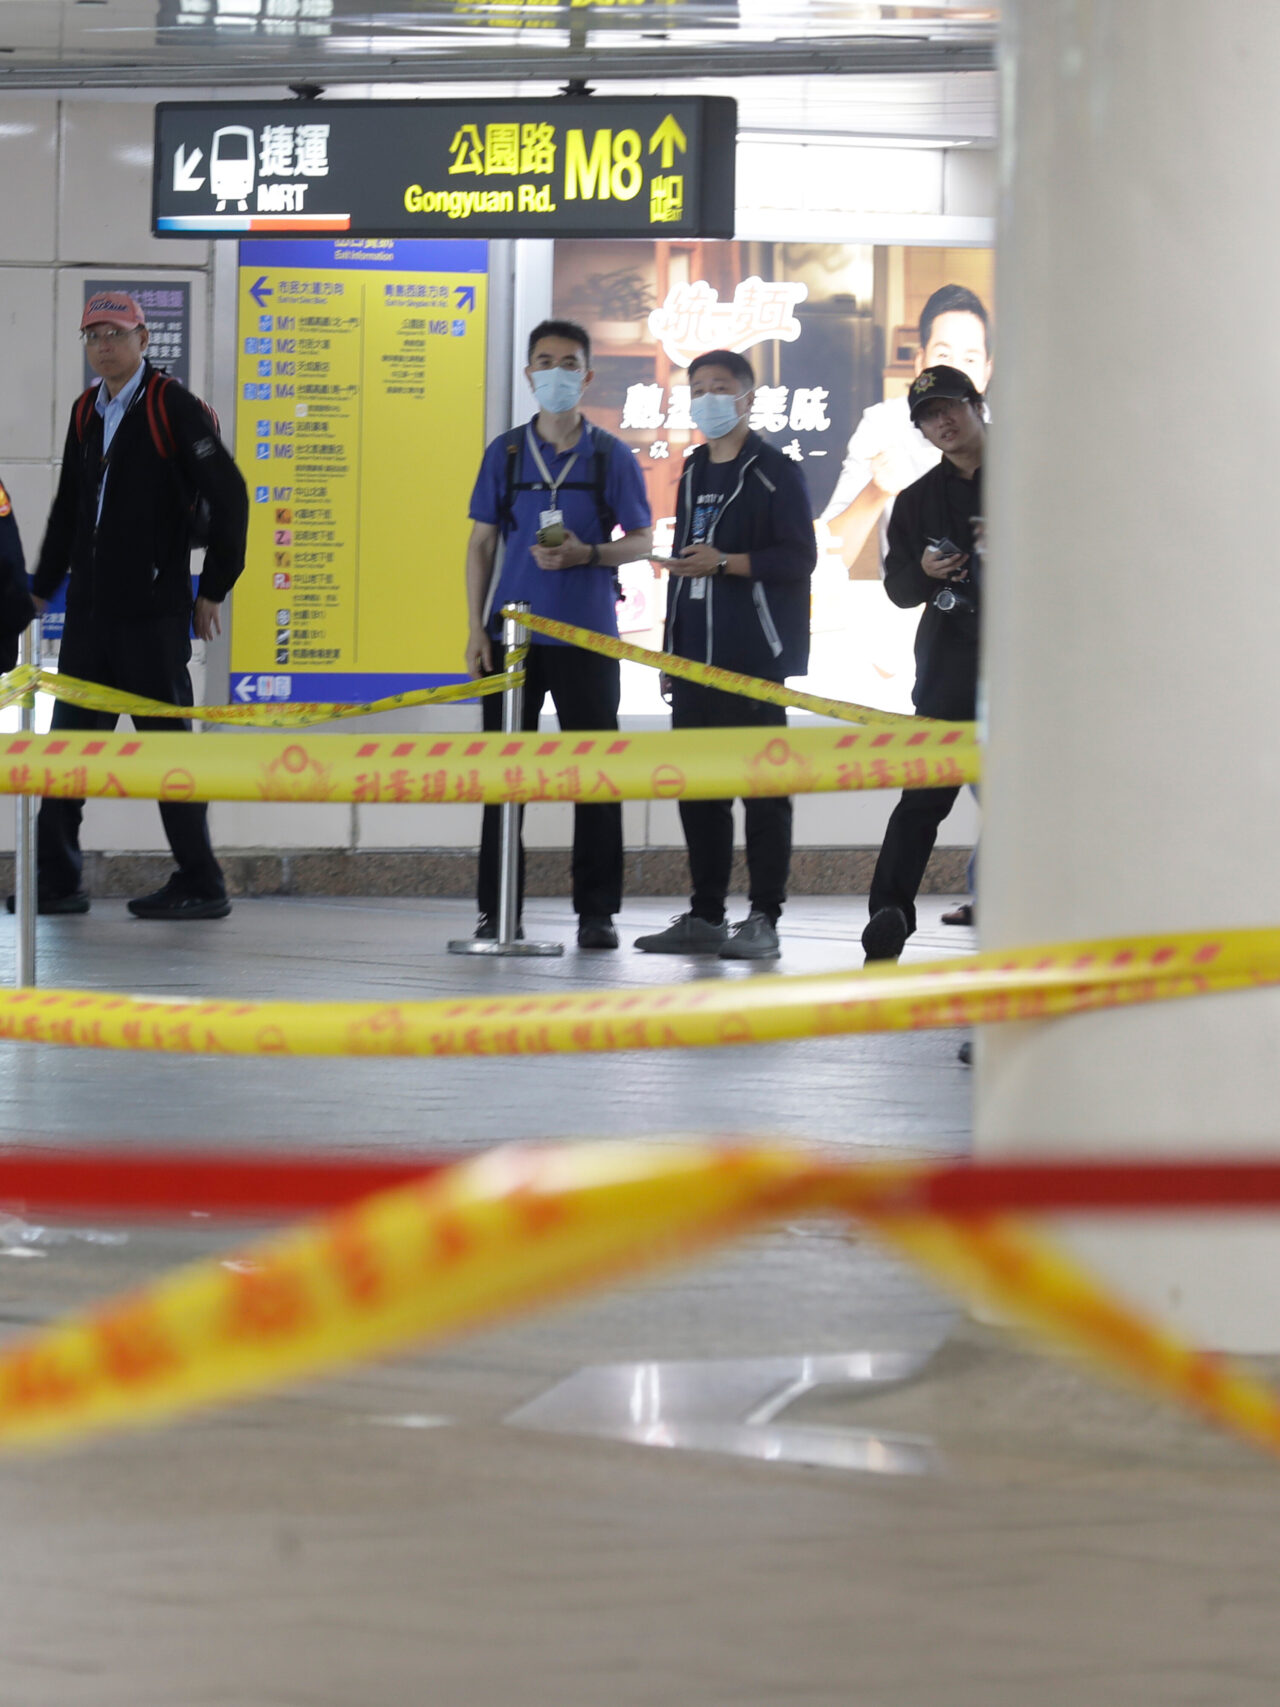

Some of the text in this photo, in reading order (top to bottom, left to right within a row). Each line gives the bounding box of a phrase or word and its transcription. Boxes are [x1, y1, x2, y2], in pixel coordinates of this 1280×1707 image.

[259, 124, 330, 177] 捷運
[448, 122, 557, 176] 公園路
[564, 129, 643, 201] M8
[257, 183, 308, 212] MRT
[404, 184, 556, 218] Gongyuan Rd.
[276, 315, 295, 331] M1
[663, 285, 794, 345] 統一麵
[428, 319, 448, 335] M8
[276, 338, 296, 354] M2
[276, 361, 296, 376] M3
[275, 384, 295, 399] M4
[274, 421, 295, 436] M5
[274, 443, 294, 459] M6
[273, 487, 293, 502] M7
[498, 763, 622, 803] 禁止進入
